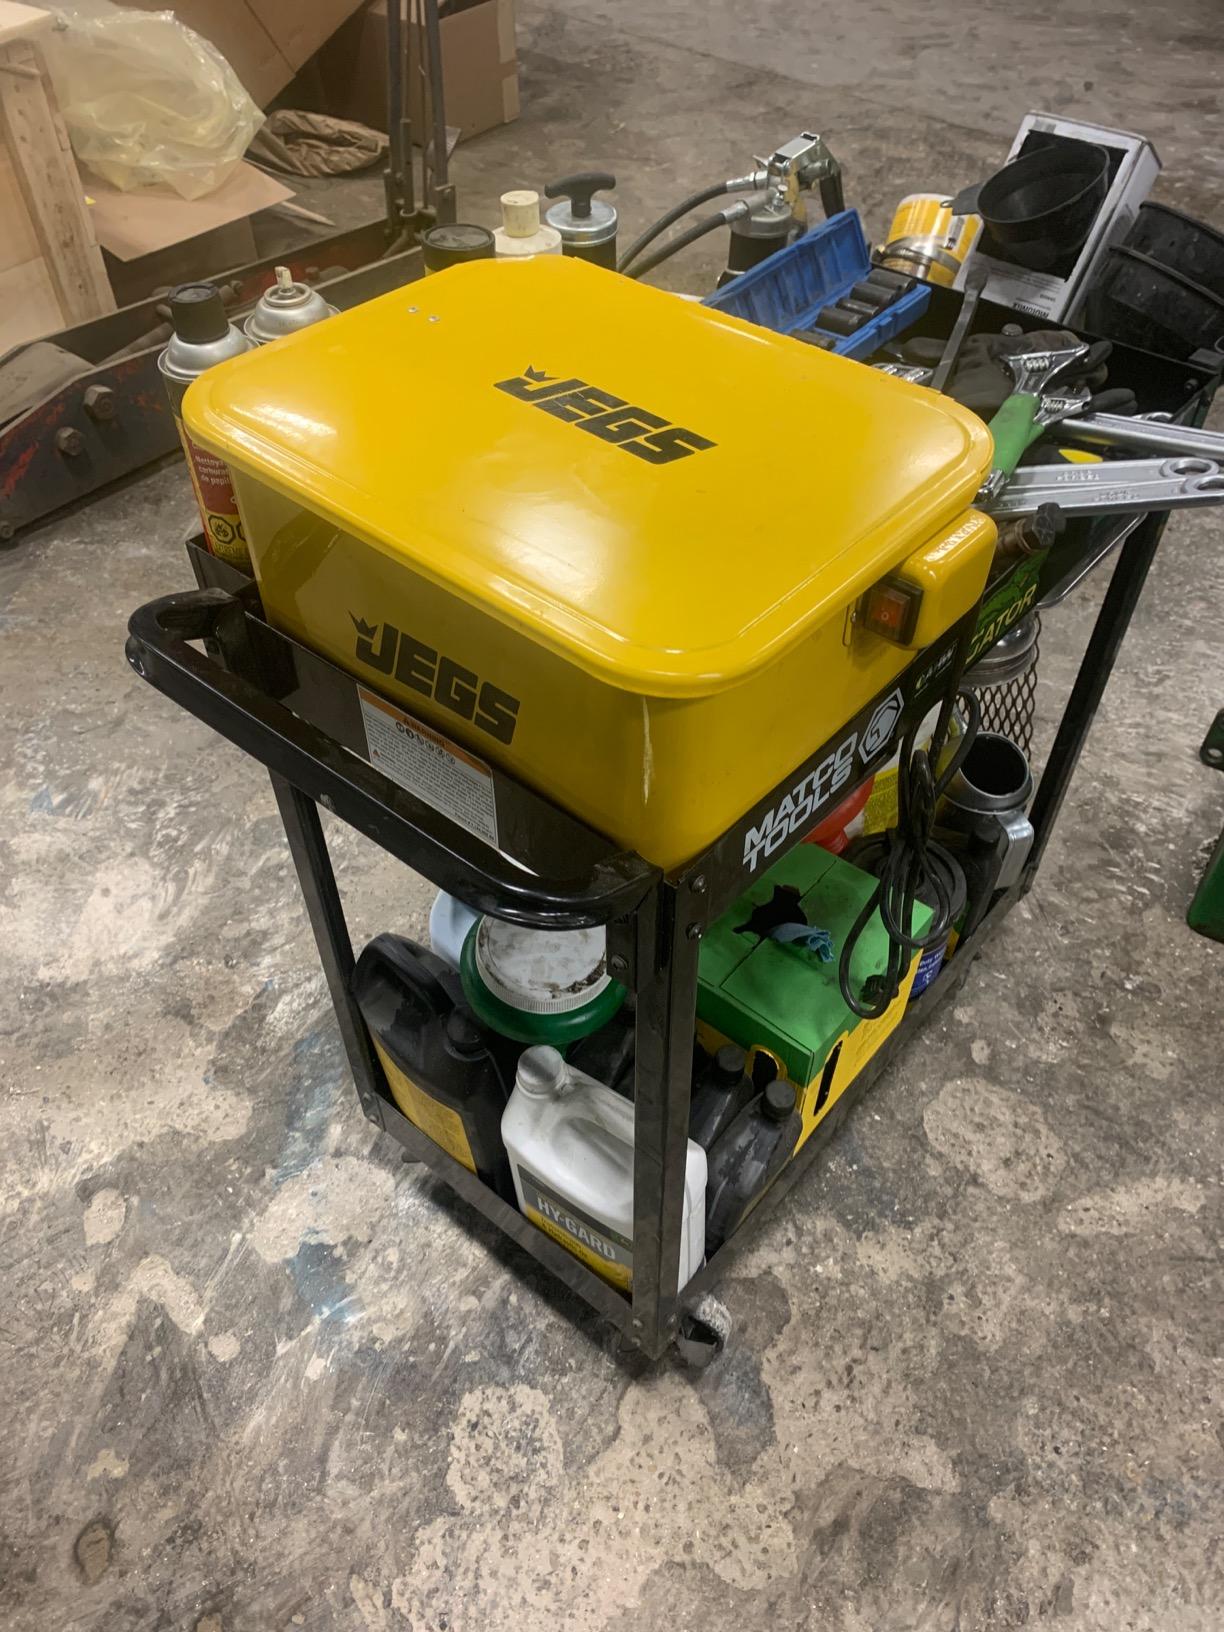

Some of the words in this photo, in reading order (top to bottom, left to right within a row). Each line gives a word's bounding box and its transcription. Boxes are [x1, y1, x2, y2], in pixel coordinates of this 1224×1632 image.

[493, 374, 719, 465] JEGS
[356, 621, 521, 746] JEGS
[742, 756, 854, 873] TOOLS
[743, 731, 858, 859] MATCO
[537, 1196, 616, 1260] HY-GARD
